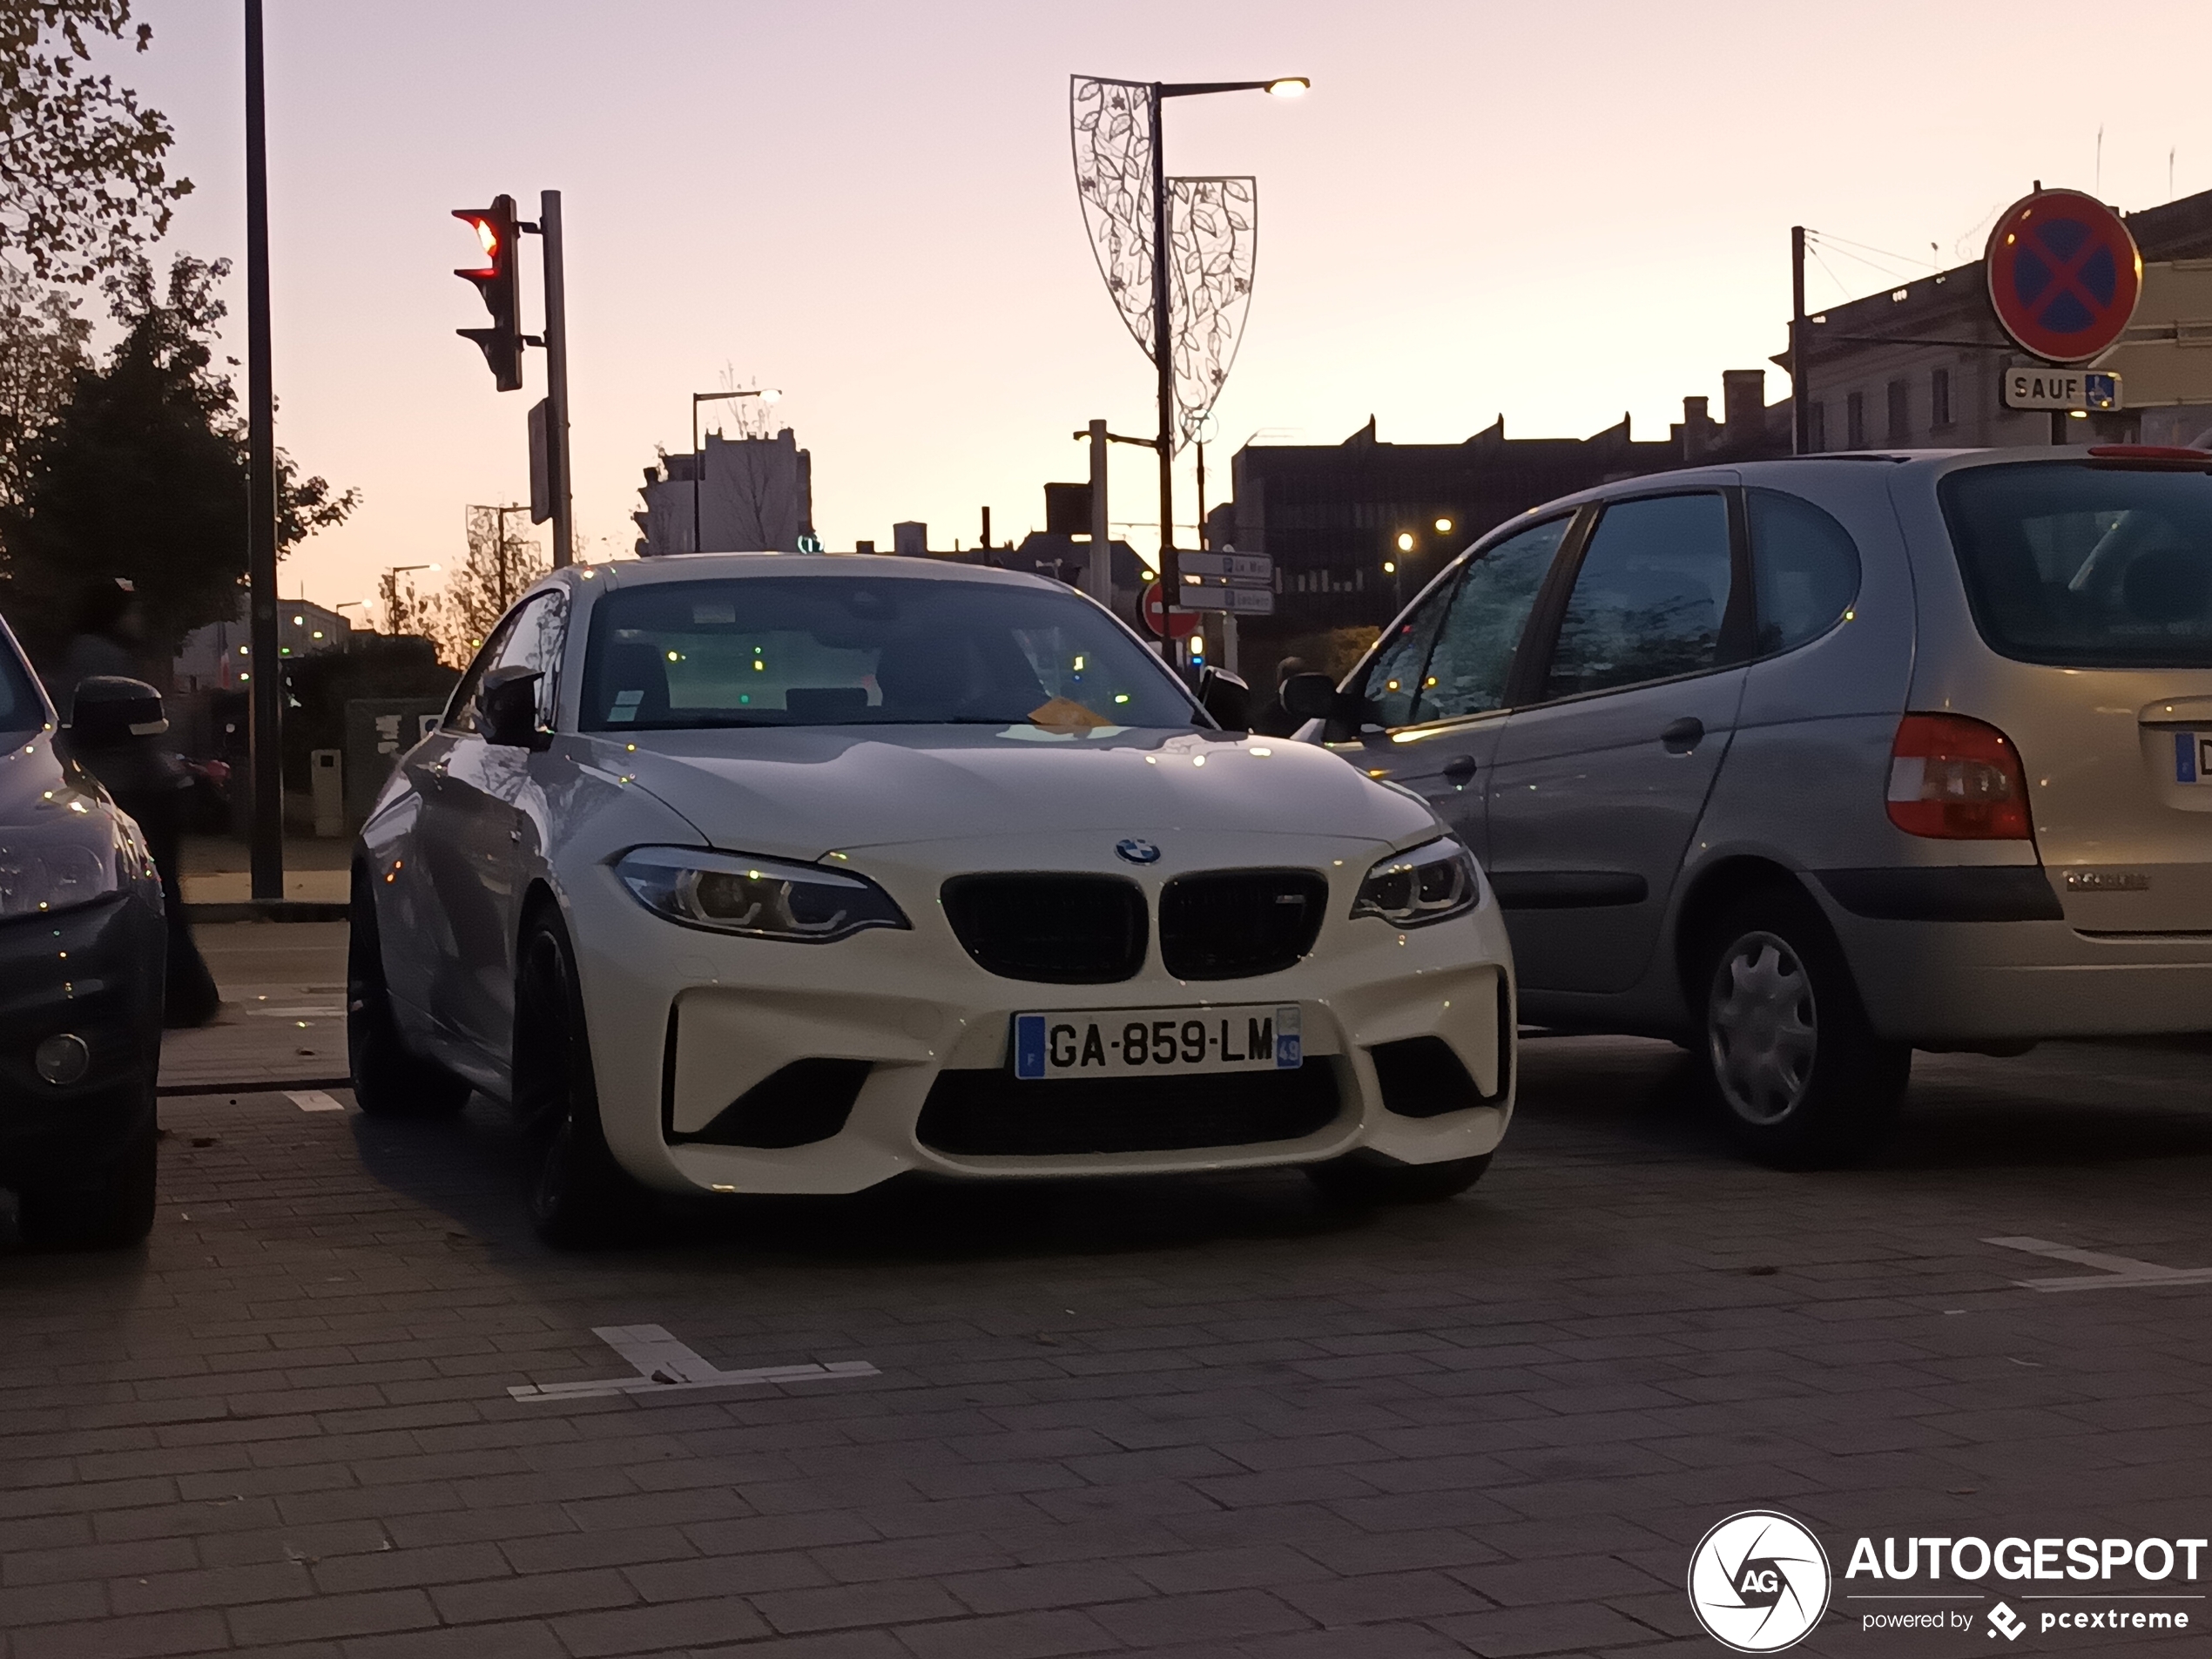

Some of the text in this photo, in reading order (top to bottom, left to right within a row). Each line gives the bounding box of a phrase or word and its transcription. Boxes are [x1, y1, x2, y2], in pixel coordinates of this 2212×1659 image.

[2014, 376, 2079, 400] SAUF
[1049, 1017, 1273, 1068] GA-859-LM
[1280, 1041, 1300, 1062] 49
[1027, 1053, 1035, 1067] F
